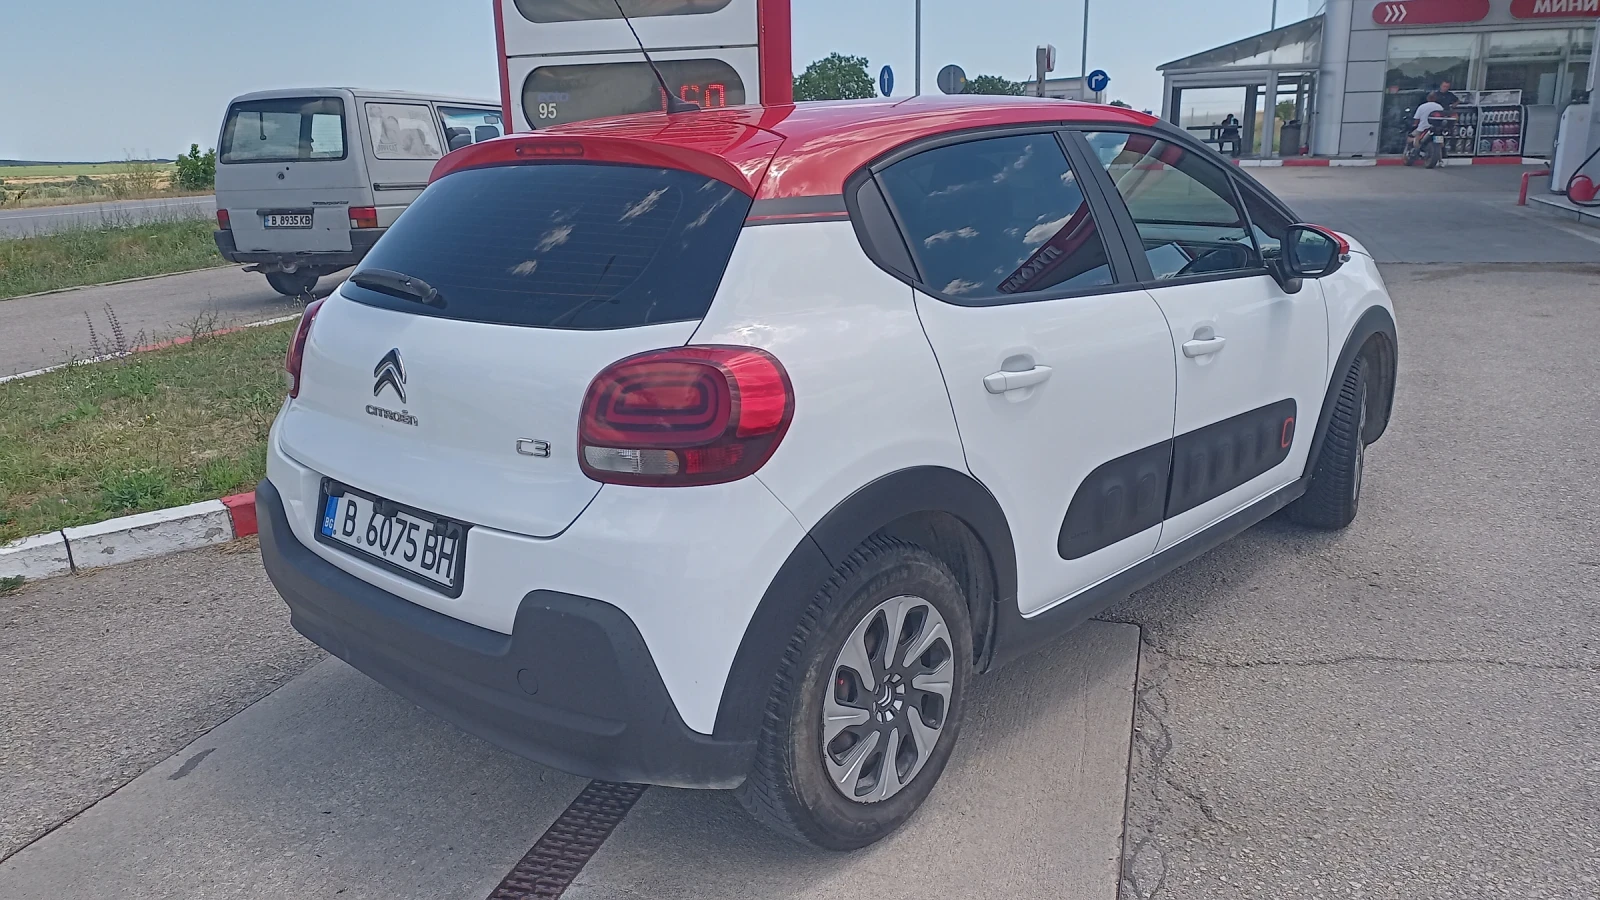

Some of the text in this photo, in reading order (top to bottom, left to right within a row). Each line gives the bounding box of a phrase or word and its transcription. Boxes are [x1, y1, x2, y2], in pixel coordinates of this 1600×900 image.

[1533, 0, 1599, 14] МИНИ
[539, 102, 557, 119] 95
[516, 437, 551, 458] C3
[324, 516, 334, 529] BG
